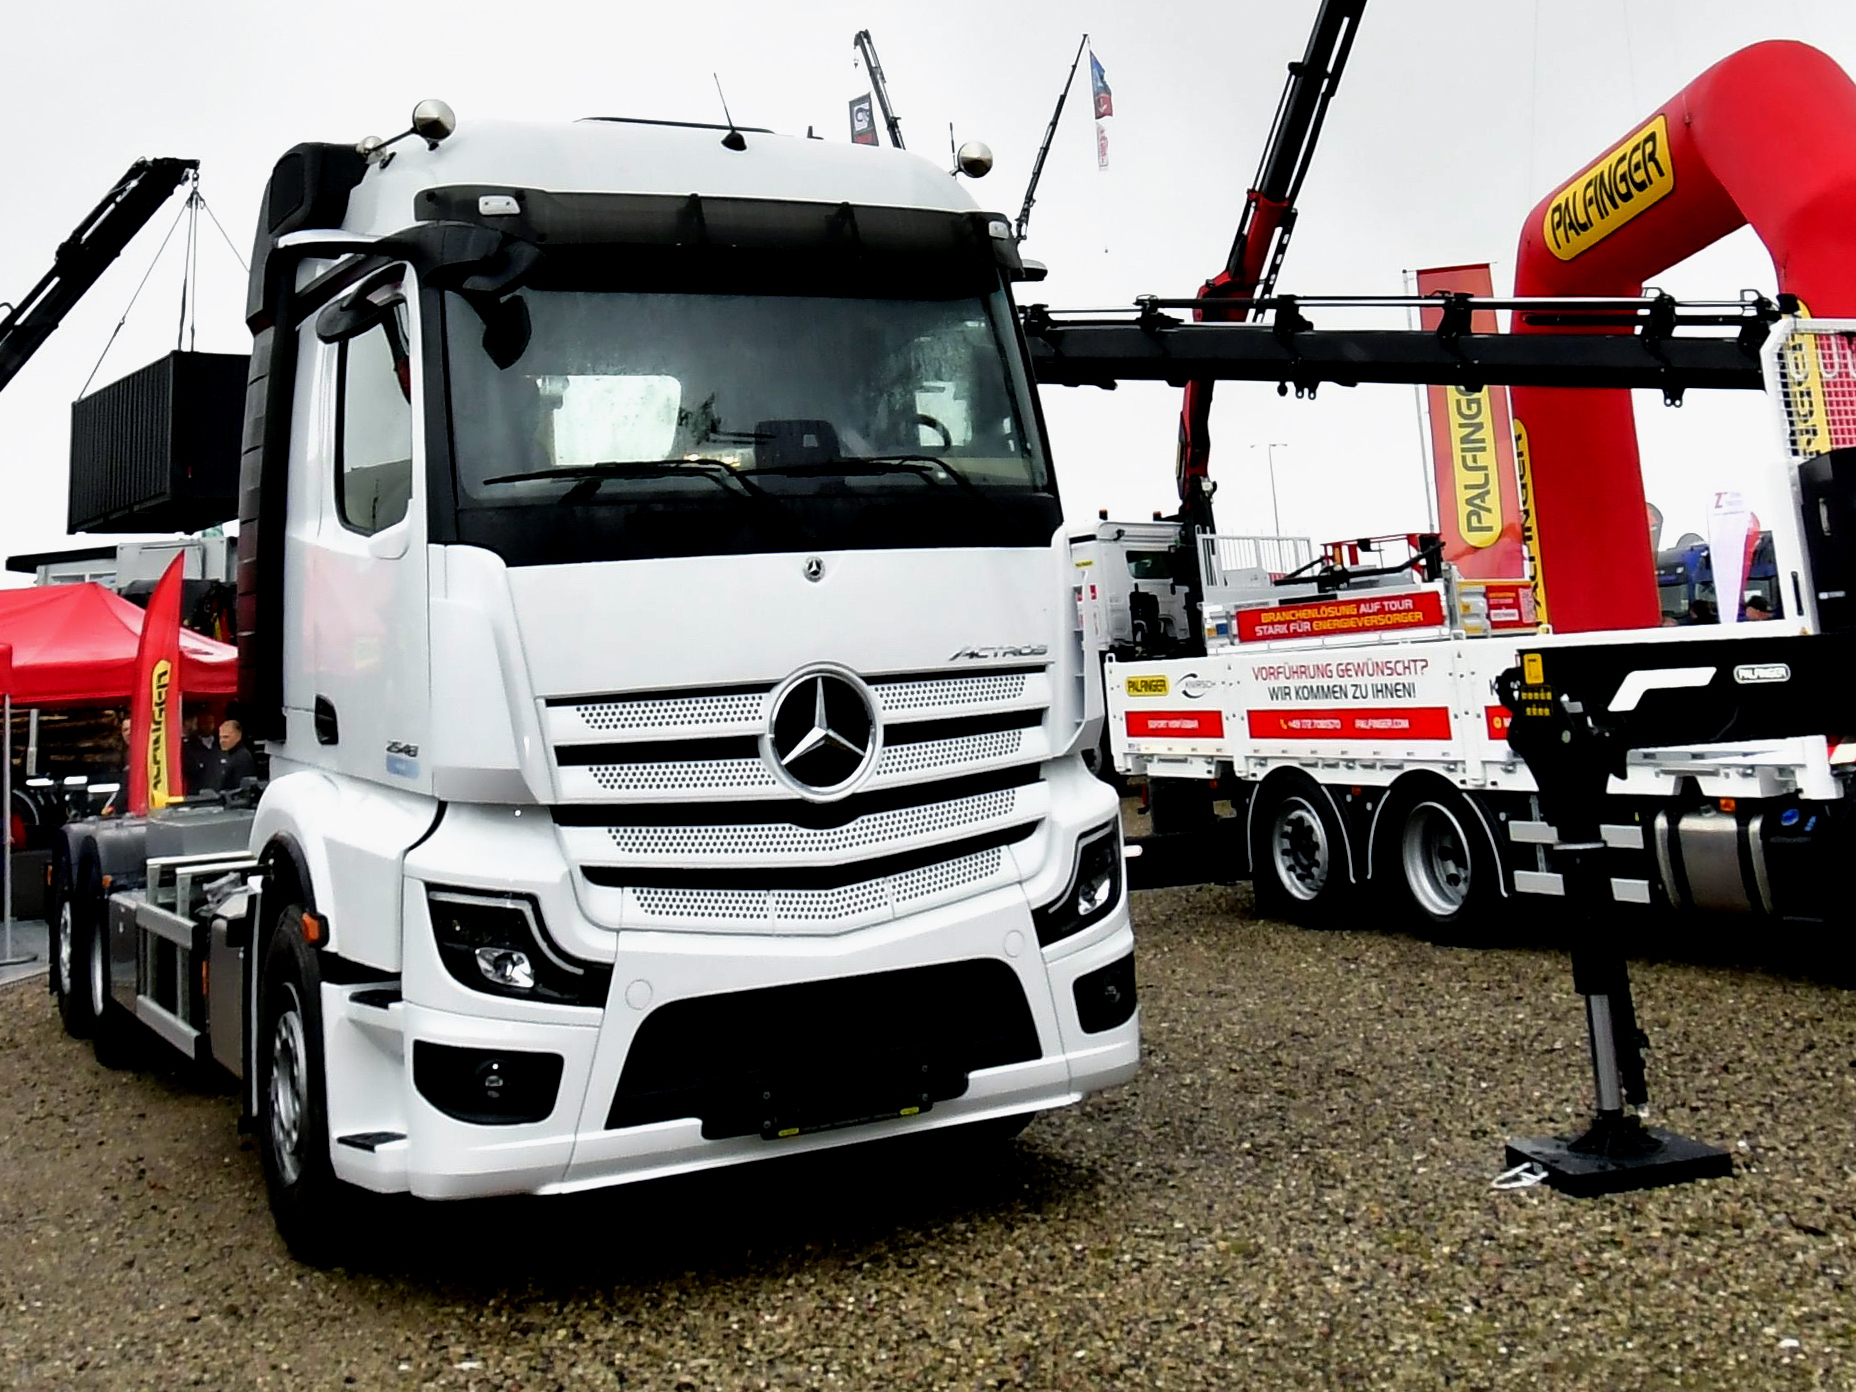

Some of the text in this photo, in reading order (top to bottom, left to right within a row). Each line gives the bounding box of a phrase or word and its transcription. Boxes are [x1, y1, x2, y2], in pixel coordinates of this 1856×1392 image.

[1550, 130, 1665, 250] PALFINGER
[1456, 385, 1494, 534] PALFING
[1255, 611, 1424, 636] STARK FÜR ENERGIEVERSORGER
[1261, 598, 1414, 624] BRANCHENLÖSUNG AUF TOUR
[1252, 657, 1429, 681] VORFÜHRUNG GEWÜNSCHT?
[1267, 682, 1416, 701] WIR KOMMEN ZU IHNEN!
